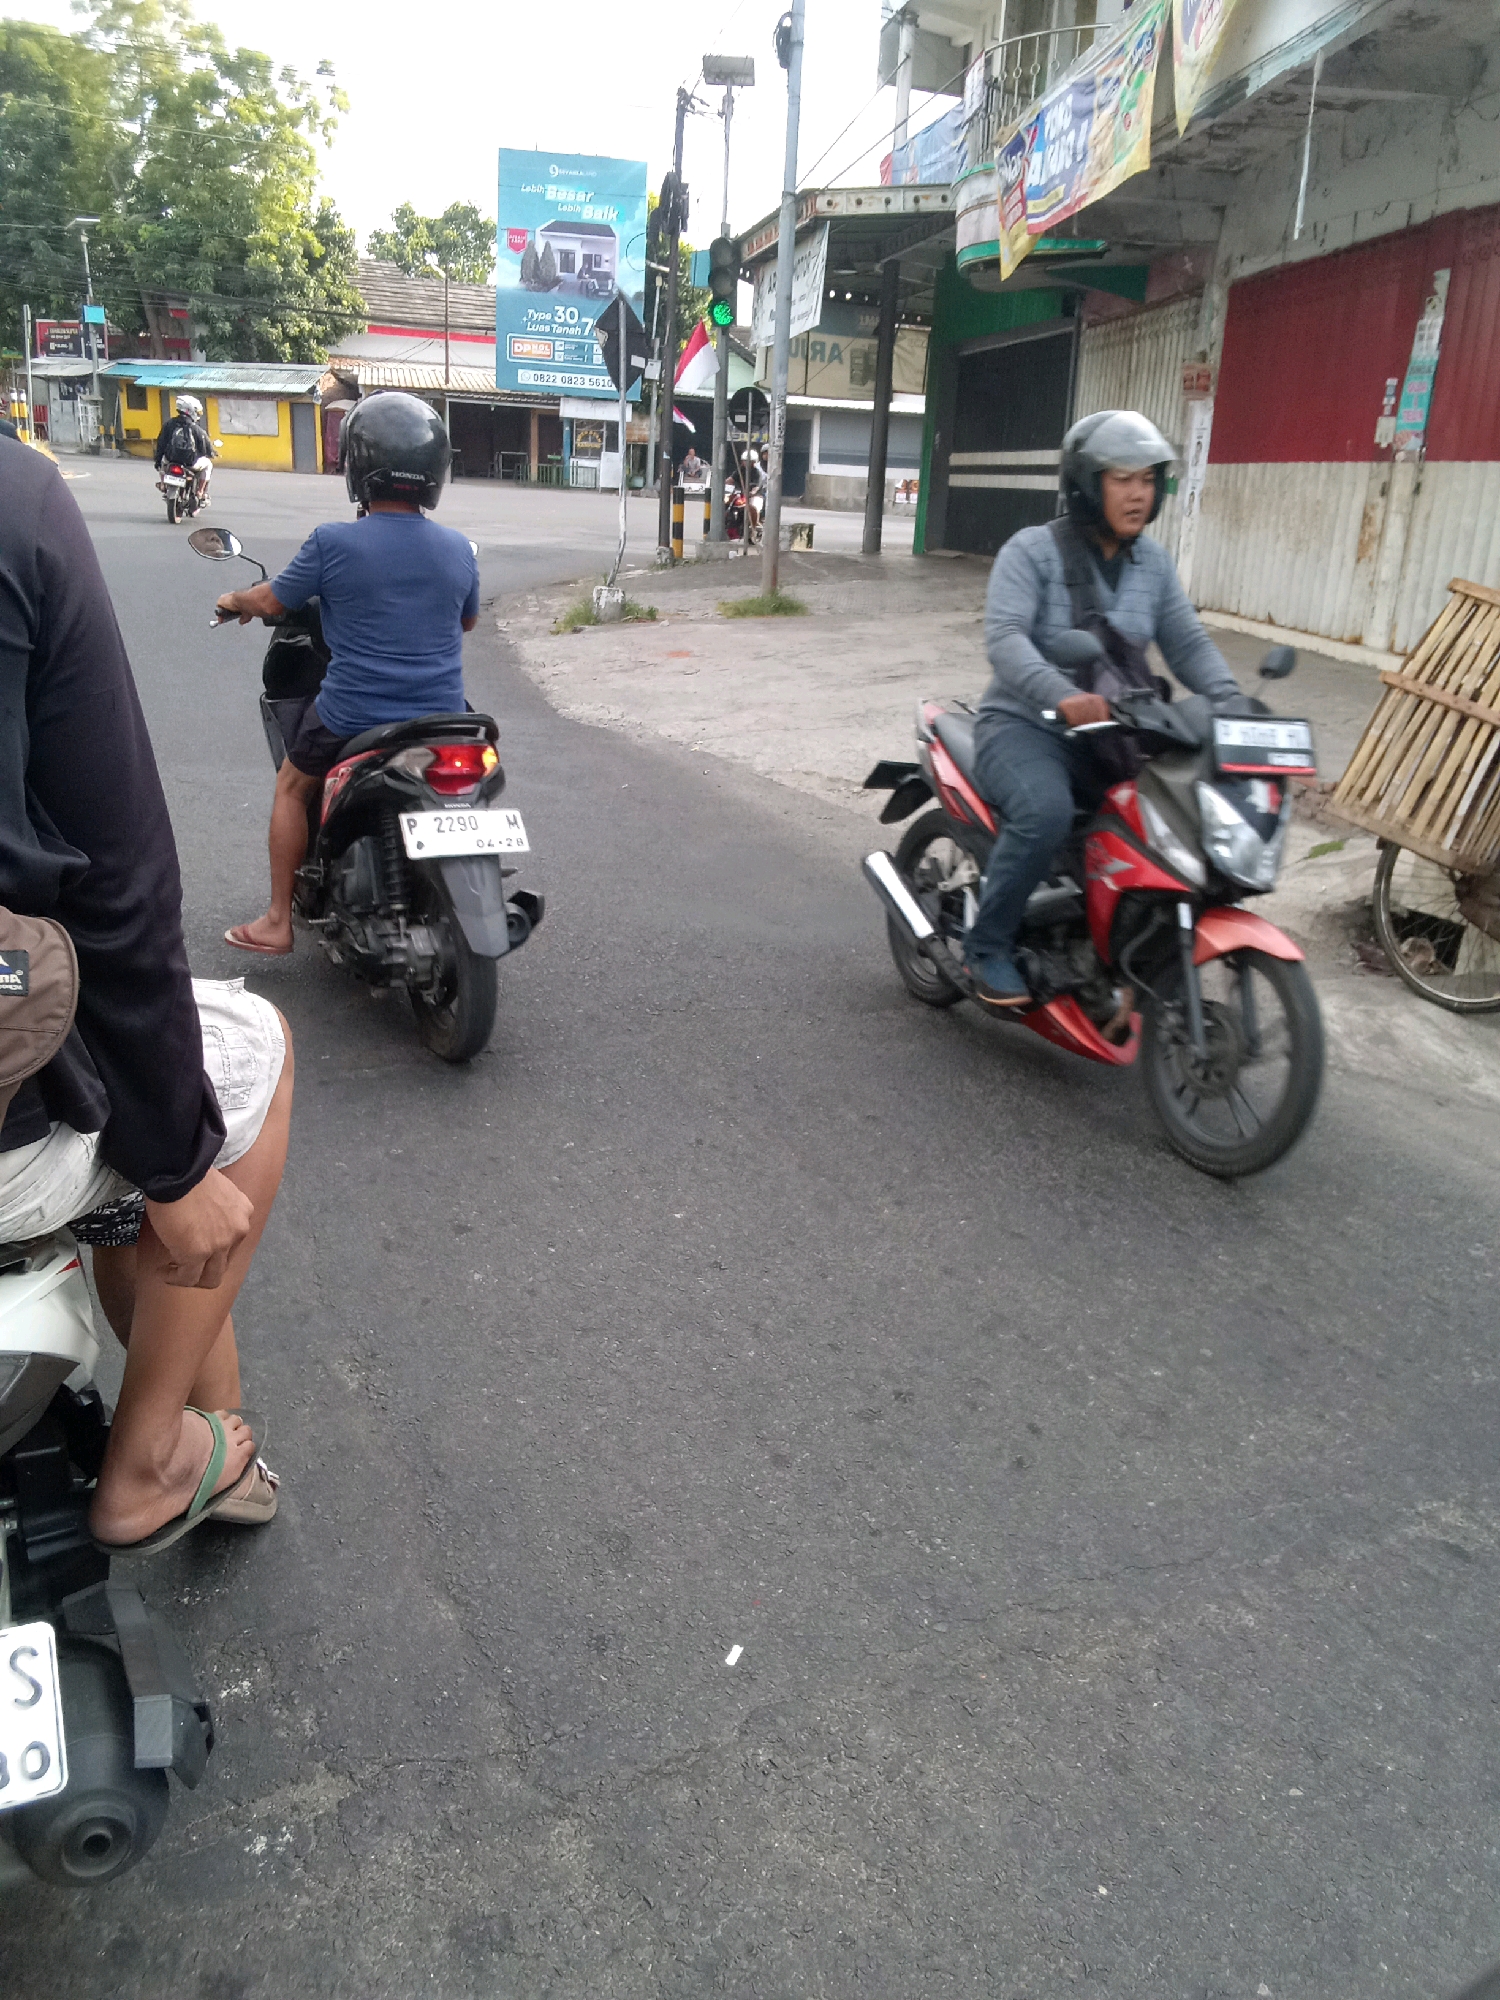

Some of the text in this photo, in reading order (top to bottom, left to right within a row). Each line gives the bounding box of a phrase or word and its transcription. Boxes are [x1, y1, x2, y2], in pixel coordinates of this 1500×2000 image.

[521, 183, 595, 203] Lebih Besar
[557, 202, 620, 221] Lebih Baik
[526, 305, 579, 324] Type 30
[526, 321, 551, 333] Luas
[552, 323, 582, 336] Tanah
[513, 342, 531, 353] DP
[533, 373, 557, 383] 0822
[561, 375, 585, 386] 0823
[391, 470, 425, 481] HONDA
[406, 813, 520, 835] P 2290 M
[9, 1645, 43, 1707] S
